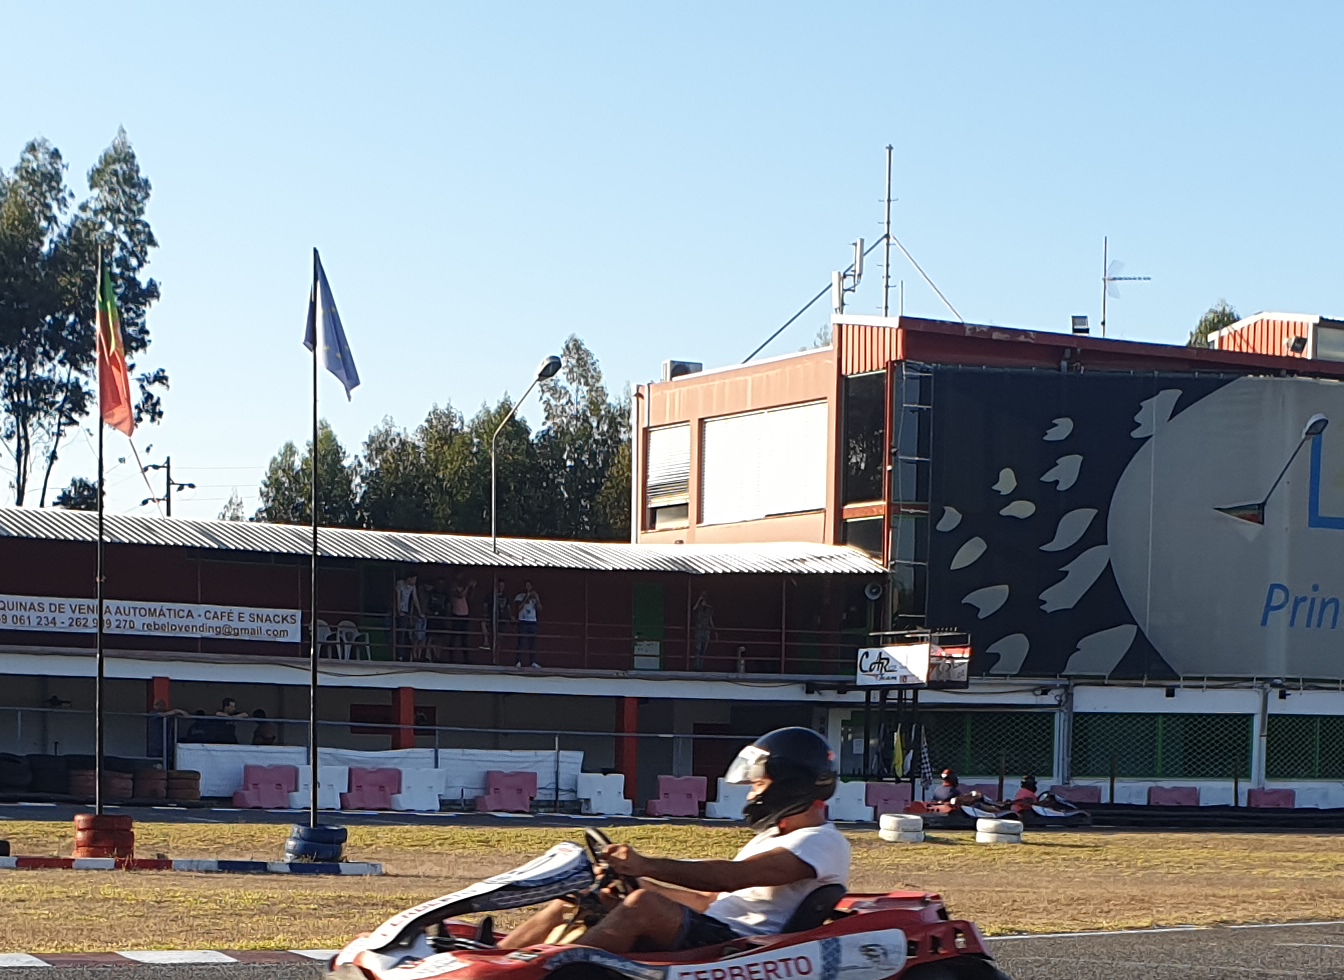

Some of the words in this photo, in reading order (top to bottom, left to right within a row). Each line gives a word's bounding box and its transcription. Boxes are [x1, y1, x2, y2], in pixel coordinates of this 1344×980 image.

[36, 615, 56, 627] 234
[92, 618, 111, 629] 99
[115, 619, 135, 630] 270
[49, 603, 65, 614] DE
[69, 604, 112, 615] VENA
[115, 606, 194, 620] AUTOMÁTICA
[205, 609, 234, 622] CAFÉ
[238, 612, 245, 623] E
[249, 613, 297, 625] SNACKS
